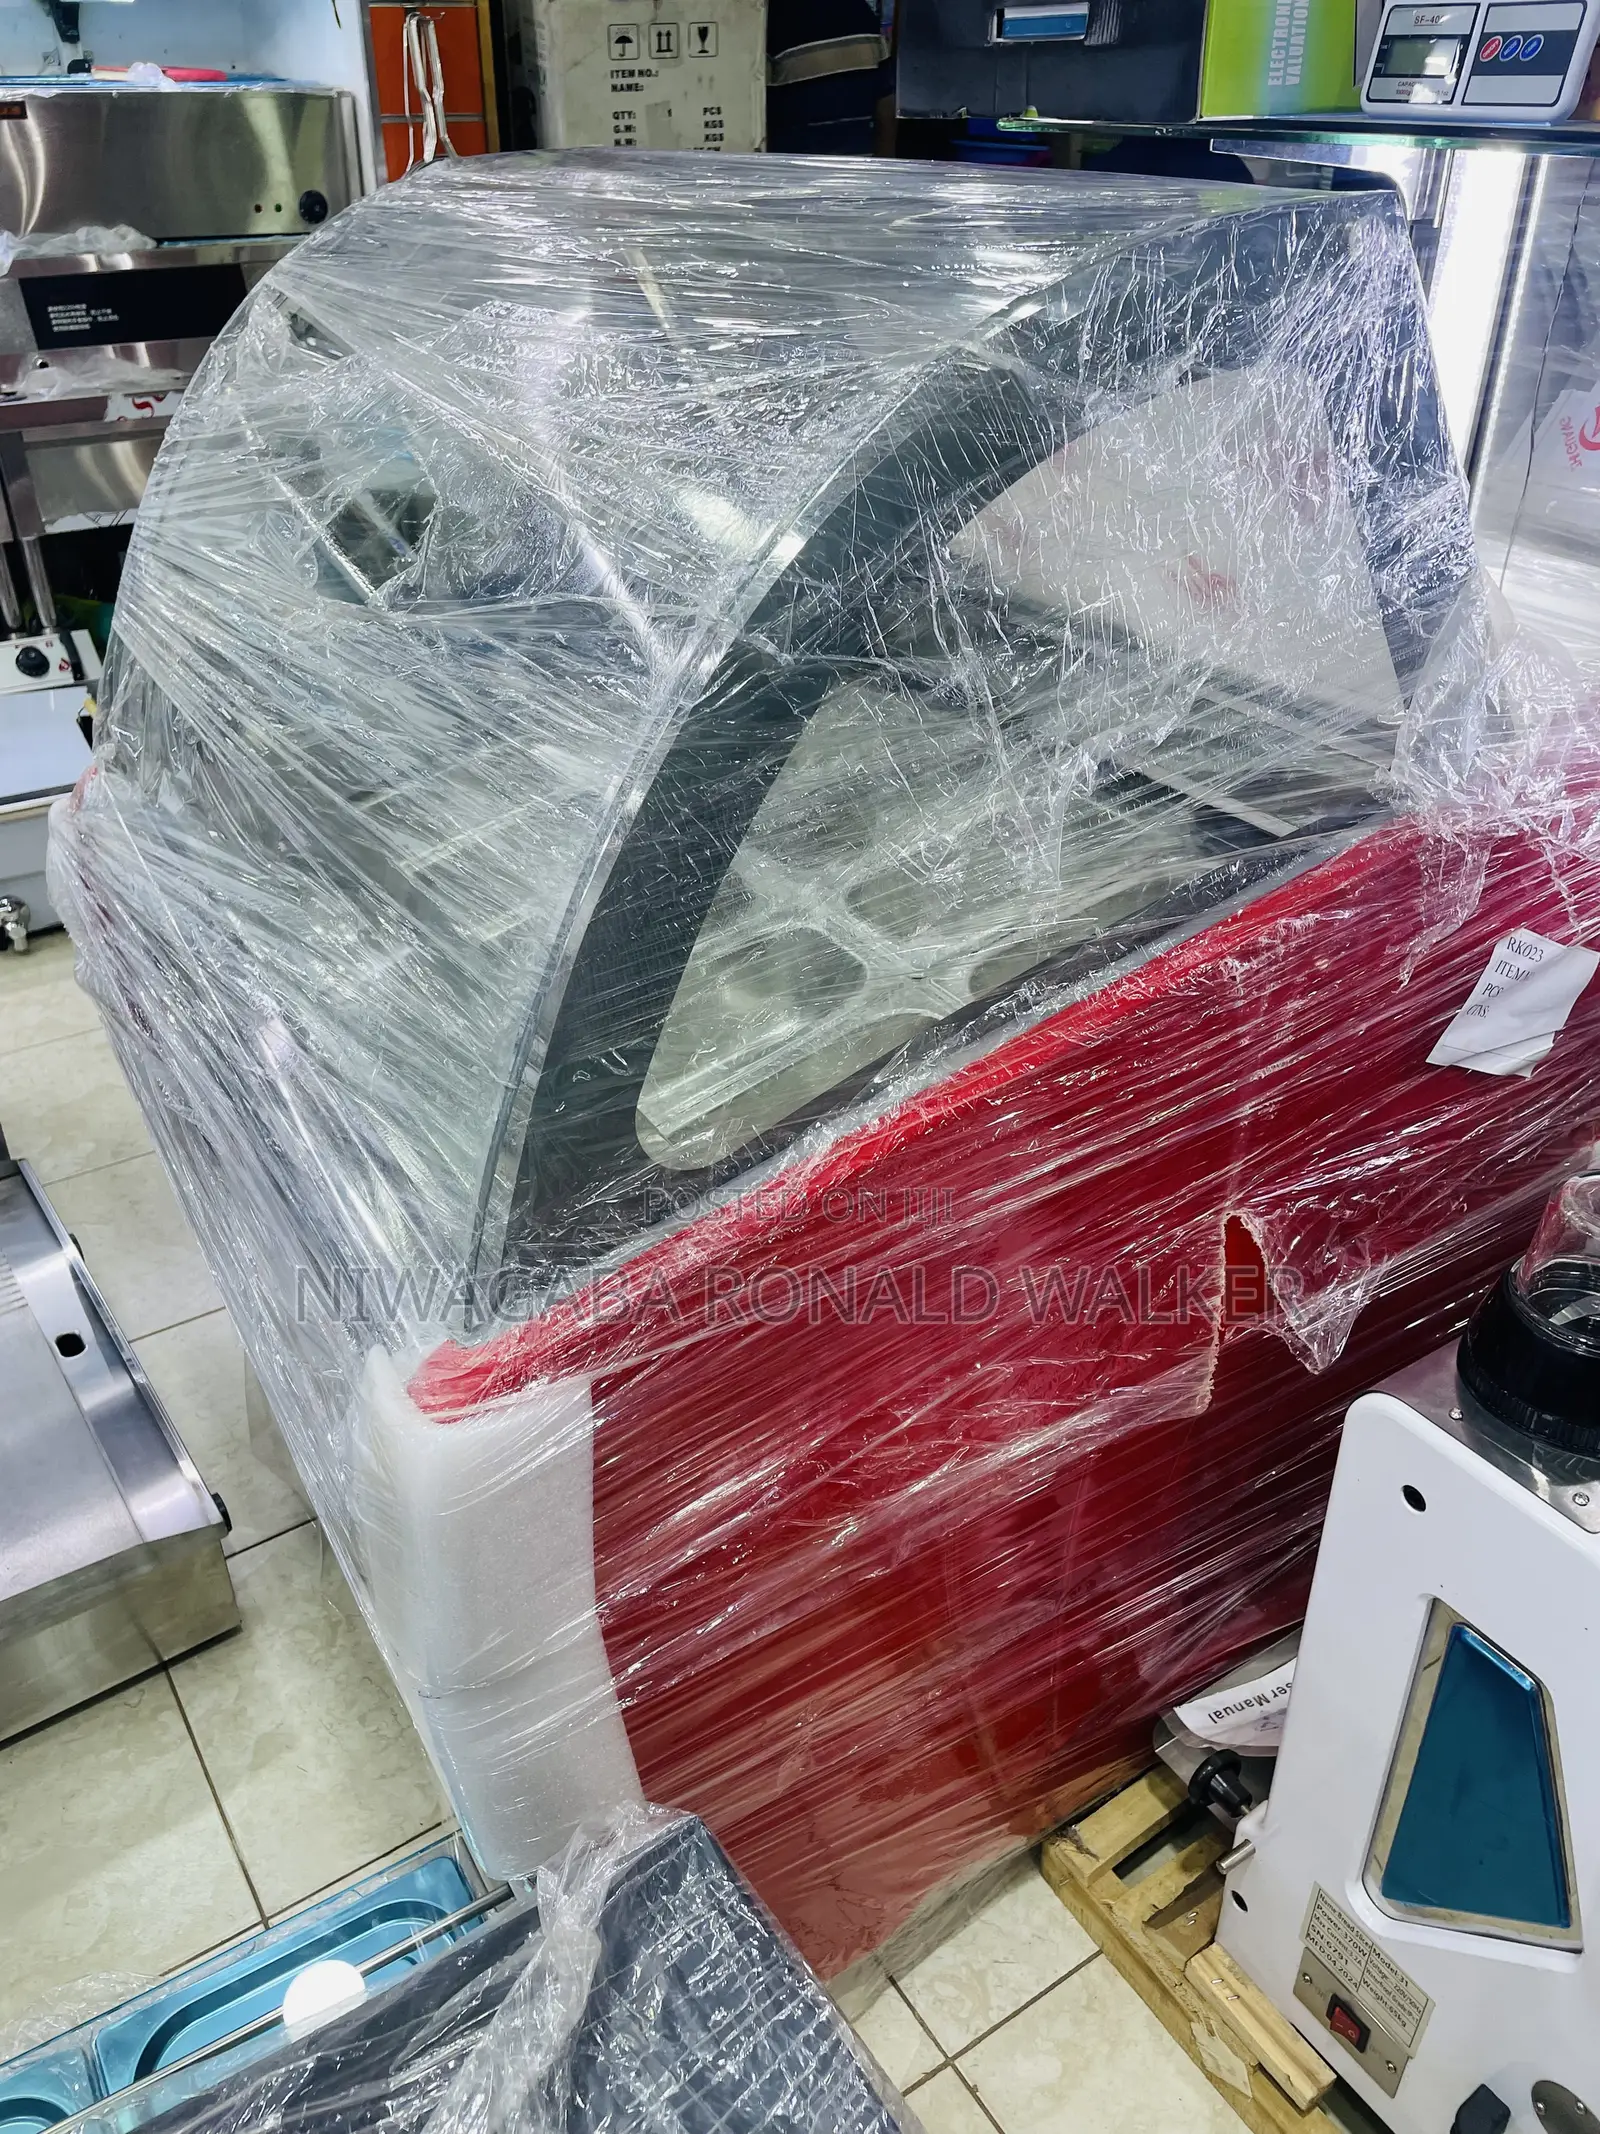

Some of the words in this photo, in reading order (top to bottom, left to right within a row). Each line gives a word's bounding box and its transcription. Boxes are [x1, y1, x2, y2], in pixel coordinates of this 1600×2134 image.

[610, 69, 635, 79] ITEM
[611, 82, 644, 92] NAME:
[612, 110, 636, 120] QTY:
[703, 106, 722, 116] PCS
[704, 119, 724, 129] KGS
[704, 133, 724, 142] KGS
[1507, 936, 1544, 963] RK023
[1271, 1682, 1293, 1699] ser
[1207, 1693, 1271, 1724] Manual
[1315, 1902, 1367, 1959] Power:370W
[1310, 1922, 1348, 1966] SN:6791
